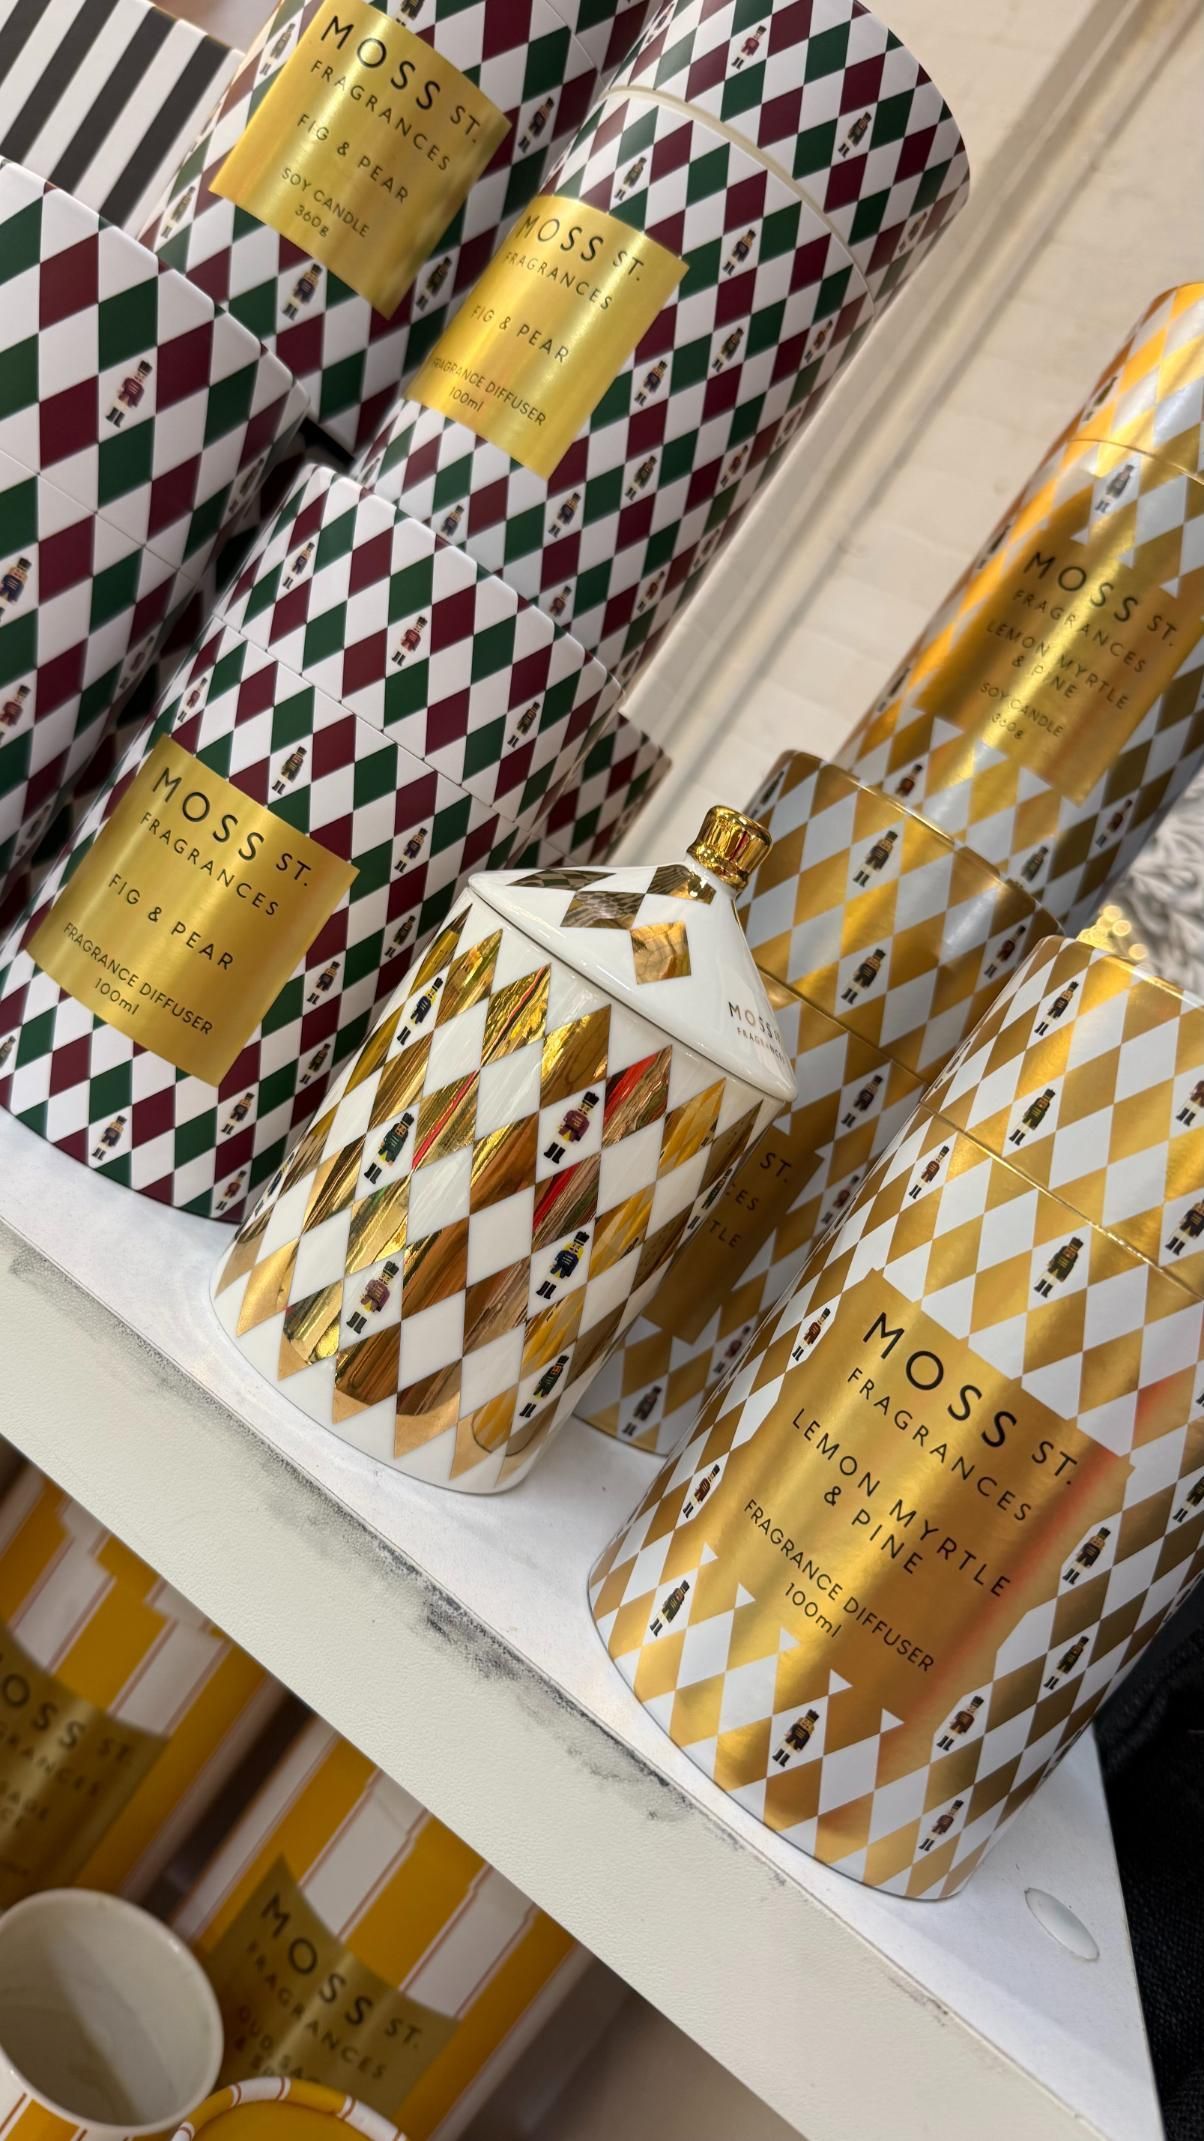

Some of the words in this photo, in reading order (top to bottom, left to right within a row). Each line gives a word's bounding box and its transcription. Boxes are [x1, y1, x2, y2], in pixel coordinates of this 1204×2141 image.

[310, 60, 450, 171] FRAGRANCES
[321, 15, 441, 110] MOSS
[450, 105, 481, 144] ST.
[281, 168, 311, 192] SOY
[313, 190, 370, 238] CANDLE
[297, 113, 329, 141] FIG
[336, 142, 350, 157] &
[358, 155, 408, 204] PEAR
[295, 205, 329, 238] 360g
[515, 215, 604, 262] MOSS
[612, 250, 645, 282] ST.
[505, 251, 612, 310] FRAGRANCES
[471, 305, 495, 322] FIG
[499, 316, 511, 330] &
[516, 324, 569, 363] PEAR
[431, 357, 486, 388] FRAGRANCE
[484, 381, 546, 427] DIFFUSER
[449, 386, 485, 413] 100ml
[1012, 589, 1146, 674] FRAGRANCES
[1023, 551, 1138, 623] MOSS
[1146, 615, 1179, 647] ST.
[980, 682, 1008, 700] SOY
[1008, 698, 1064, 737] CANDLE
[986, 620, 1050, 657] LEMON
[1056, 653, 1130, 710] MYRTLE
[1011, 654, 1025, 669] &
[1031, 665, 1079, 699] PNE
[140, 811, 279, 916] FRAGRANCES
[152, 767, 265, 861] MOSS
[275, 852, 312, 886] ST.
[107, 873, 141, 904] FIG
[147, 906, 163, 922] &
[171, 921, 234, 970] PEAR
[63, 922, 139, 988] FRAGRANCE
[139, 982, 213, 1035] DIFFUSER
[94, 978, 139, 1016] 100ml
[759, 1152, 792, 1183] ST.
[862, 1311, 1017, 1449] MOSS
[1031, 1440, 1078, 1486] ST.
[847, 1367, 1033, 1522] FRAGRANCES
[792, 1407, 880, 1497] LEMON
[888, 1498, 1011, 1598] MYRTLE
[823, 1486, 842, 1507] &
[851, 1508, 924, 1576] PINE
[743, 1498, 843, 1601] FRAGRANCE
[842, 1597, 934, 1673] DIFFUSER
[785, 1581, 842, 1639] 100ml
[0, 1670, 85, 1750] OSS
[246, 1939, 388, 2080] FRAGRANCES
[260, 1892, 373, 2026] MOSS
[384, 2016, 423, 2049] ST.
